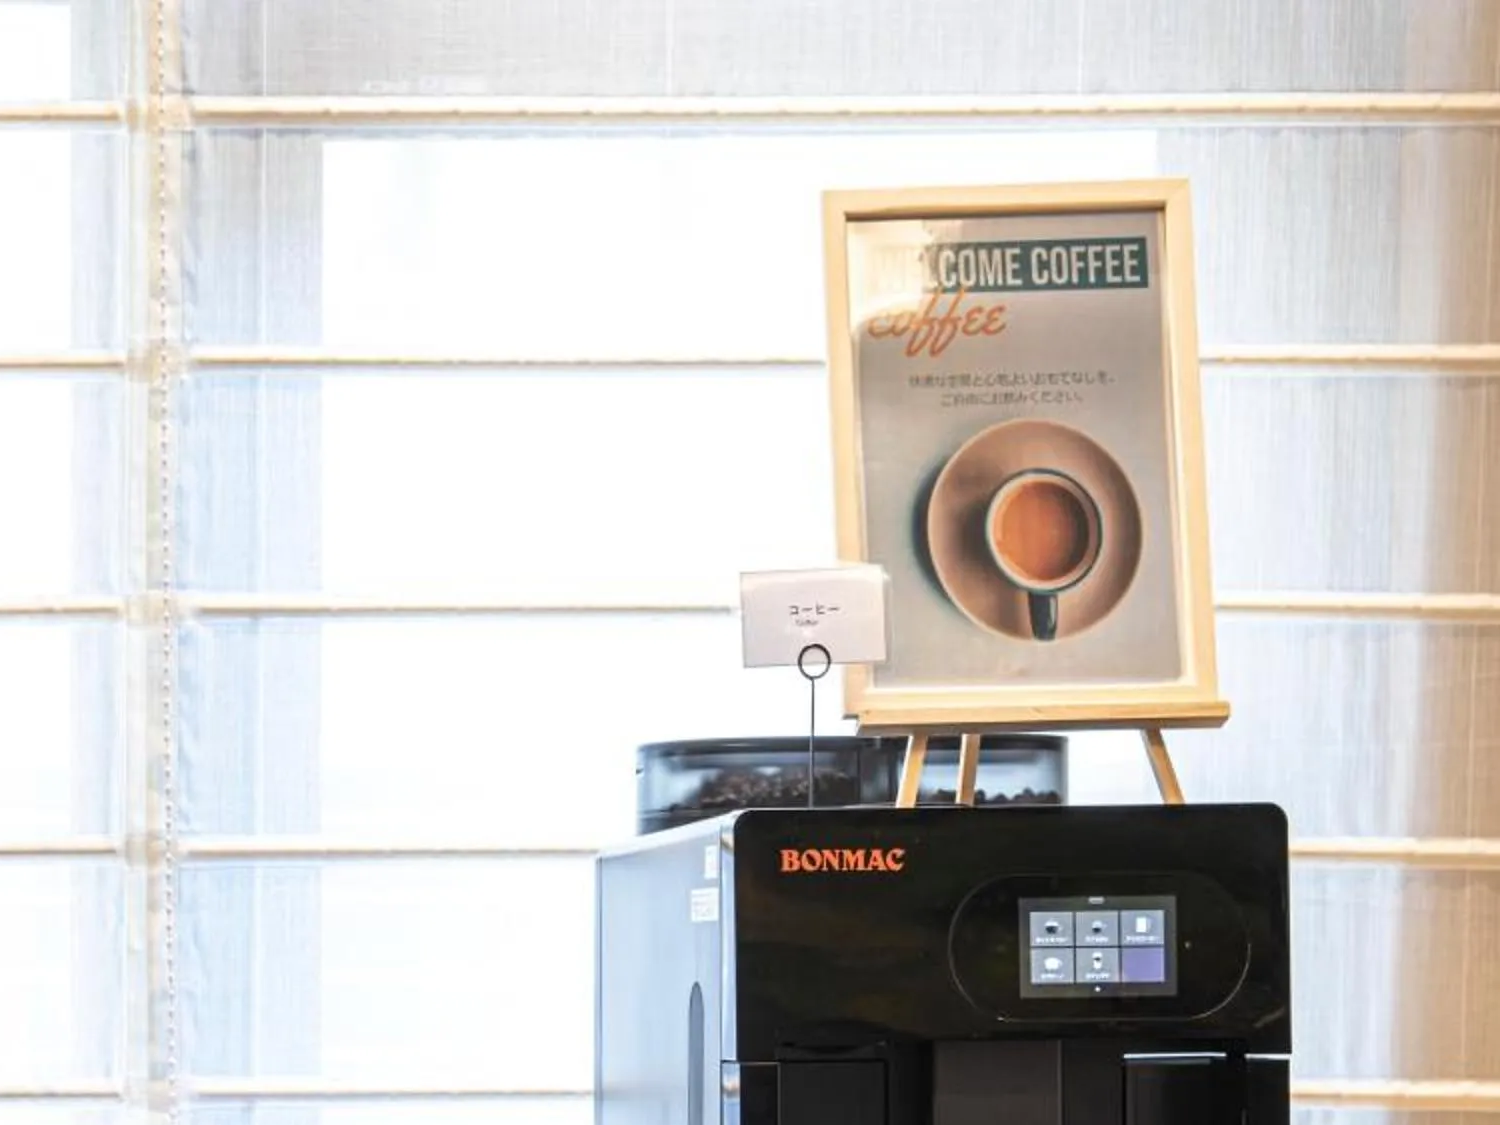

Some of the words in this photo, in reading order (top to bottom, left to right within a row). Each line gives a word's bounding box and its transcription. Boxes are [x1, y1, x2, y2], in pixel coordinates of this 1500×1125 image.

[1030, 244, 1142, 286] COFFEE
[867, 286, 1007, 358] coffee
[788, 602, 841, 616] コーヒー
[780, 848, 905, 872] BONMAC
